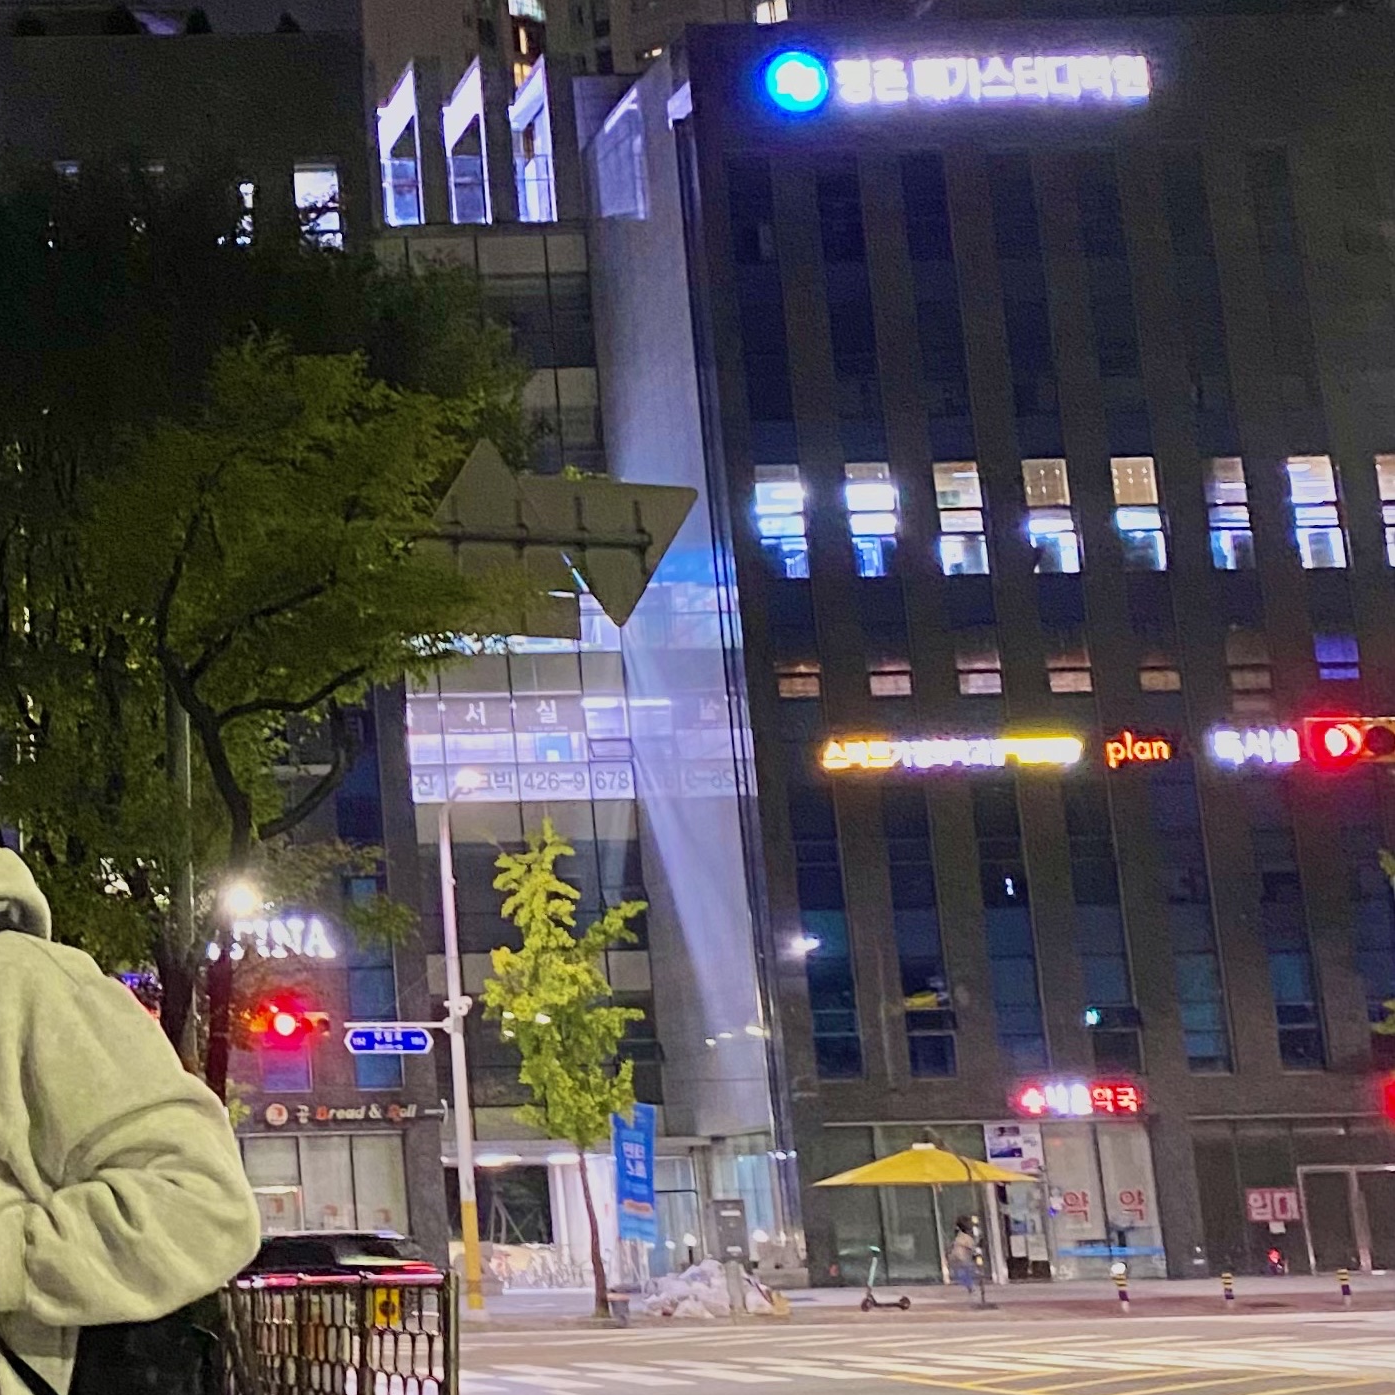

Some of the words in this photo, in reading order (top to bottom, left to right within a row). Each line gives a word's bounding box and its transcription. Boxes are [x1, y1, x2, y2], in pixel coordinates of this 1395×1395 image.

[1106, 731, 1169, 768] plan
[524, 770, 630, 793] 426-9678
[369, 1103, 382, 1120] &
[1063, 1190, 1089, 1223] 약
[1119, 1189, 1145, 1221] 약
